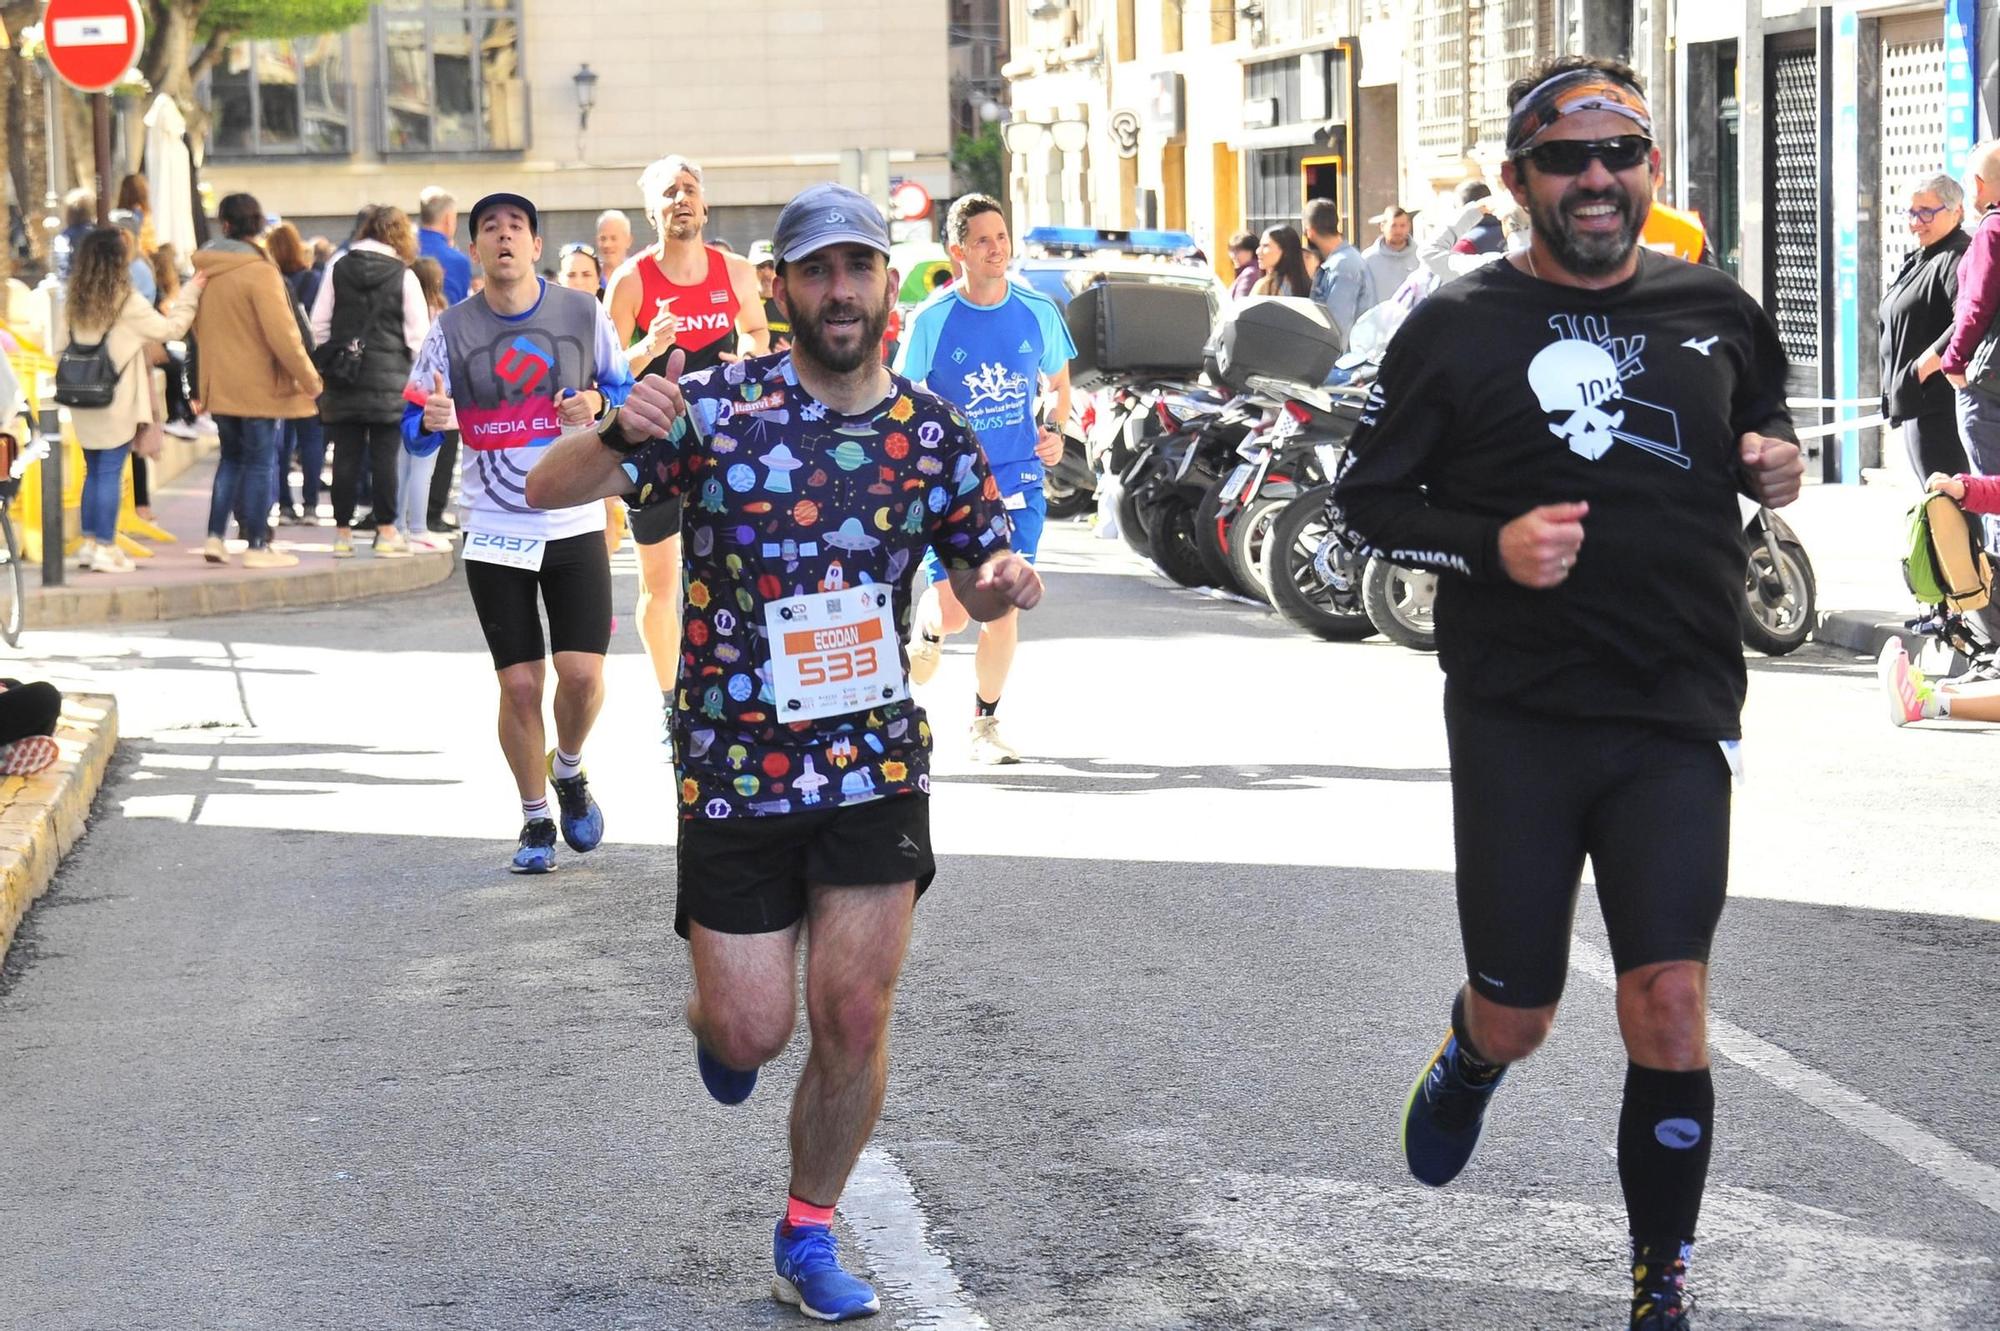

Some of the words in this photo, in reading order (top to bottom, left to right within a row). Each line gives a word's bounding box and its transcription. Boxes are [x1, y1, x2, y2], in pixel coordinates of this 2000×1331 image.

[675, 312, 729, 332] ENYA
[474, 420, 527, 435] MEDIA
[472, 532, 539, 553] 2437
[814, 625, 859, 650] ECODAN
[797, 646, 878, 687] 533
